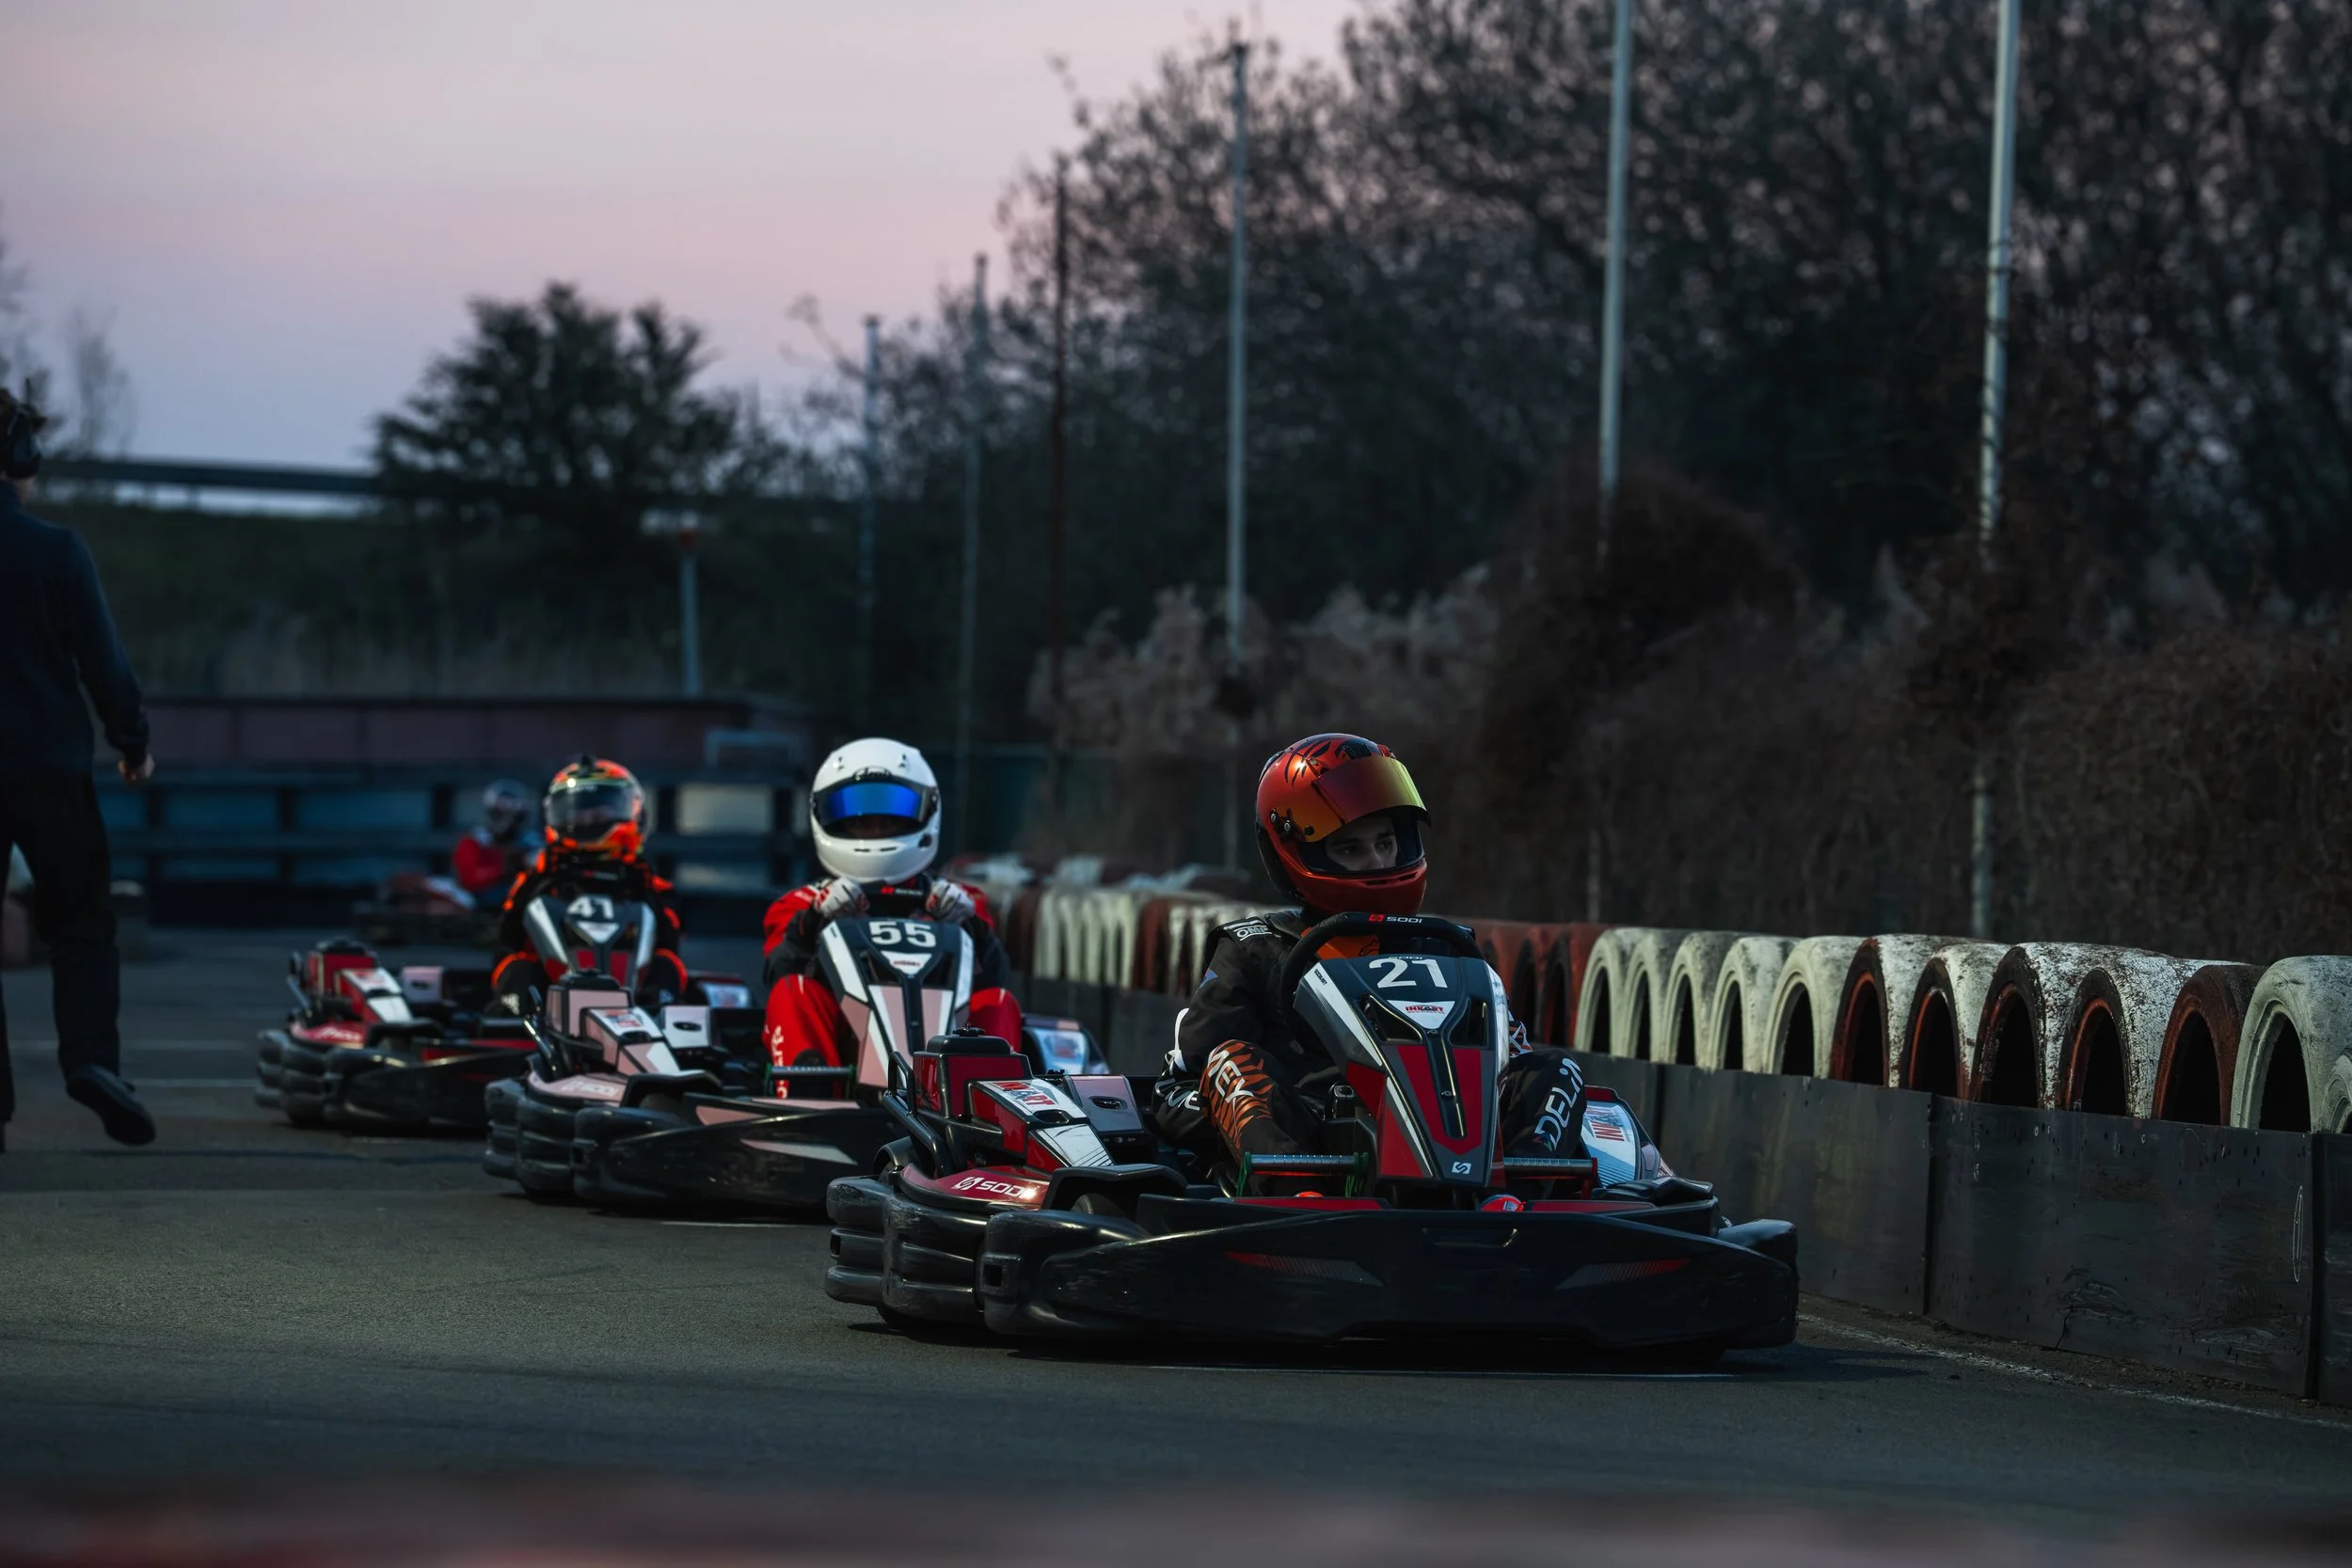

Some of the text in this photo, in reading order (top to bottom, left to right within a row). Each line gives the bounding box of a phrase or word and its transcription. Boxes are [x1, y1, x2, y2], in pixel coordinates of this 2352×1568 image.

[567, 896, 614, 920] 41
[868, 921, 936, 948] 55
[1236, 926, 1269, 938] OMP
[1368, 958, 1449, 989] 21
